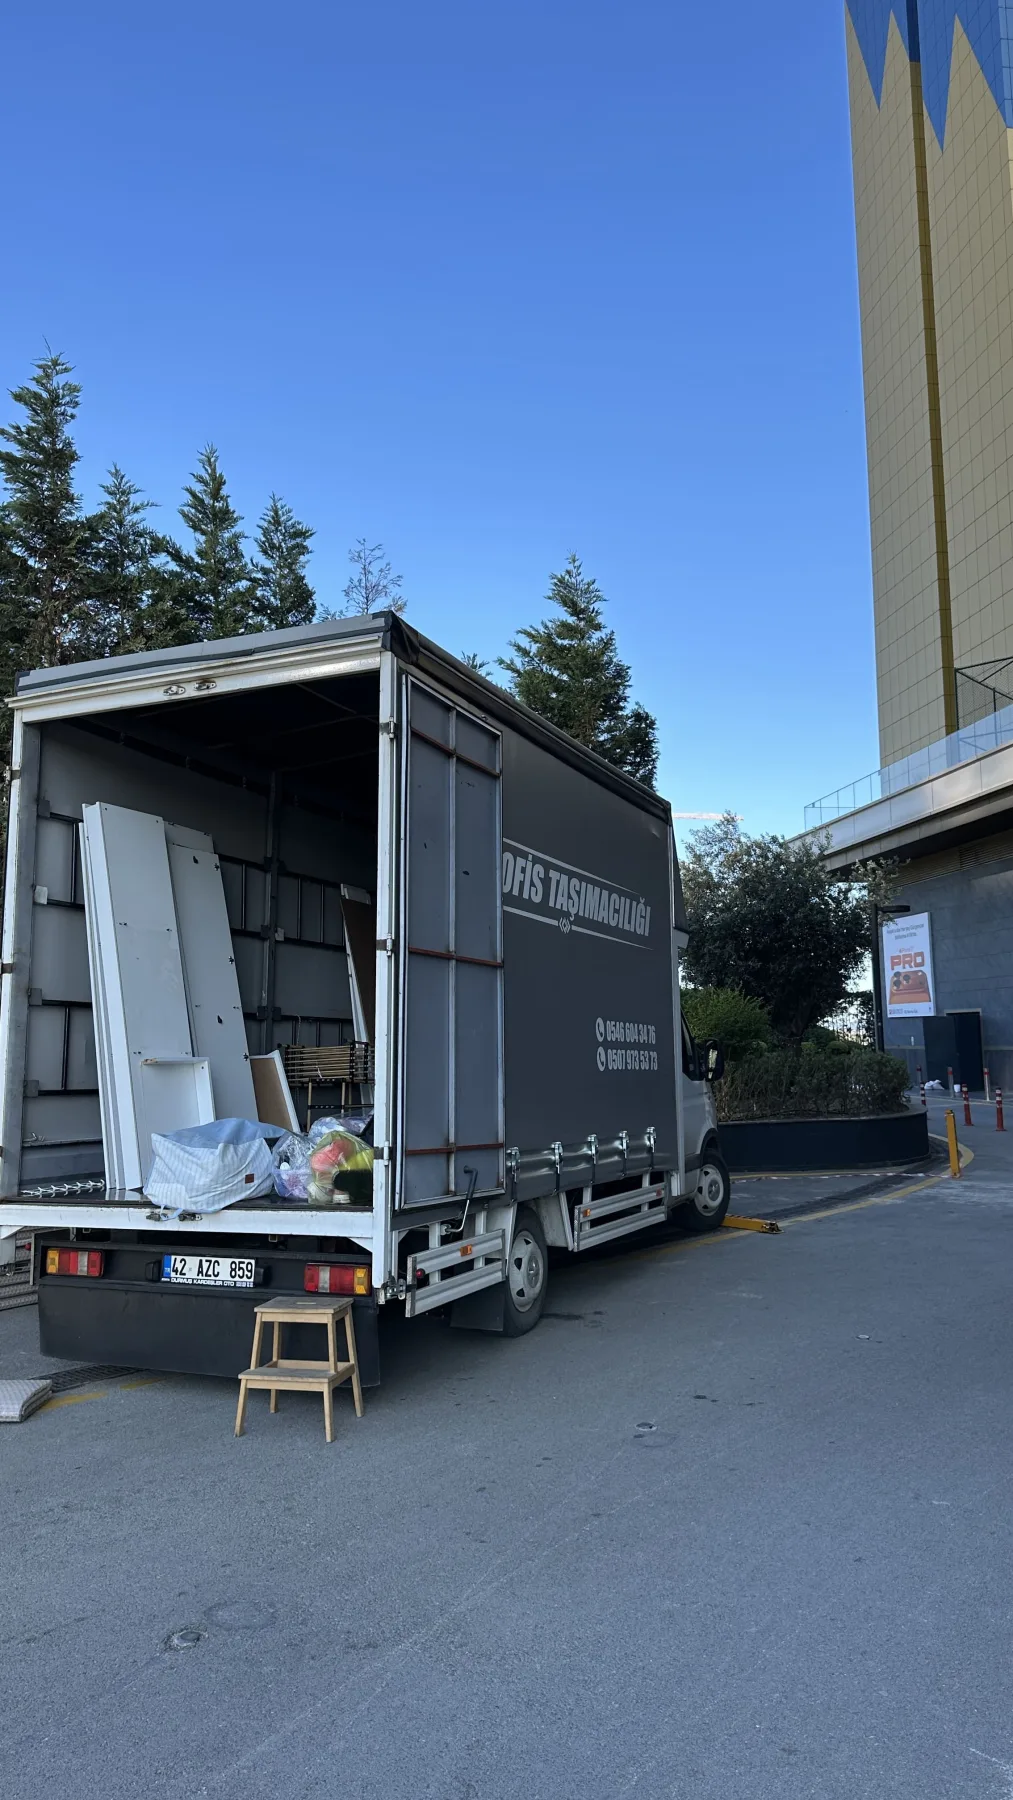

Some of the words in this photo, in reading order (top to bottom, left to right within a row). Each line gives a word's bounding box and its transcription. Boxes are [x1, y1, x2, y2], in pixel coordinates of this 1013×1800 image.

[502, 851, 545, 904] OFİS
[548, 869, 652, 937] TAŞIMACILIĞI
[890, 951, 925, 971] PRO
[606, 1020, 625, 1042] 0546
[625, 1022, 639, 1043] 604
[639, 1023, 648, 1044] 34
[648, 1024, 656, 1045] 76
[607, 1048, 626, 1070] 0507
[626, 1049, 640, 1070] 973
[640, 1050, 649, 1070] 53
[649, 1051, 658, 1071] 73
[171, 1257, 187, 1276] 42
[196, 1258, 220, 1278] AZC
[229, 1260, 253, 1280] 859
